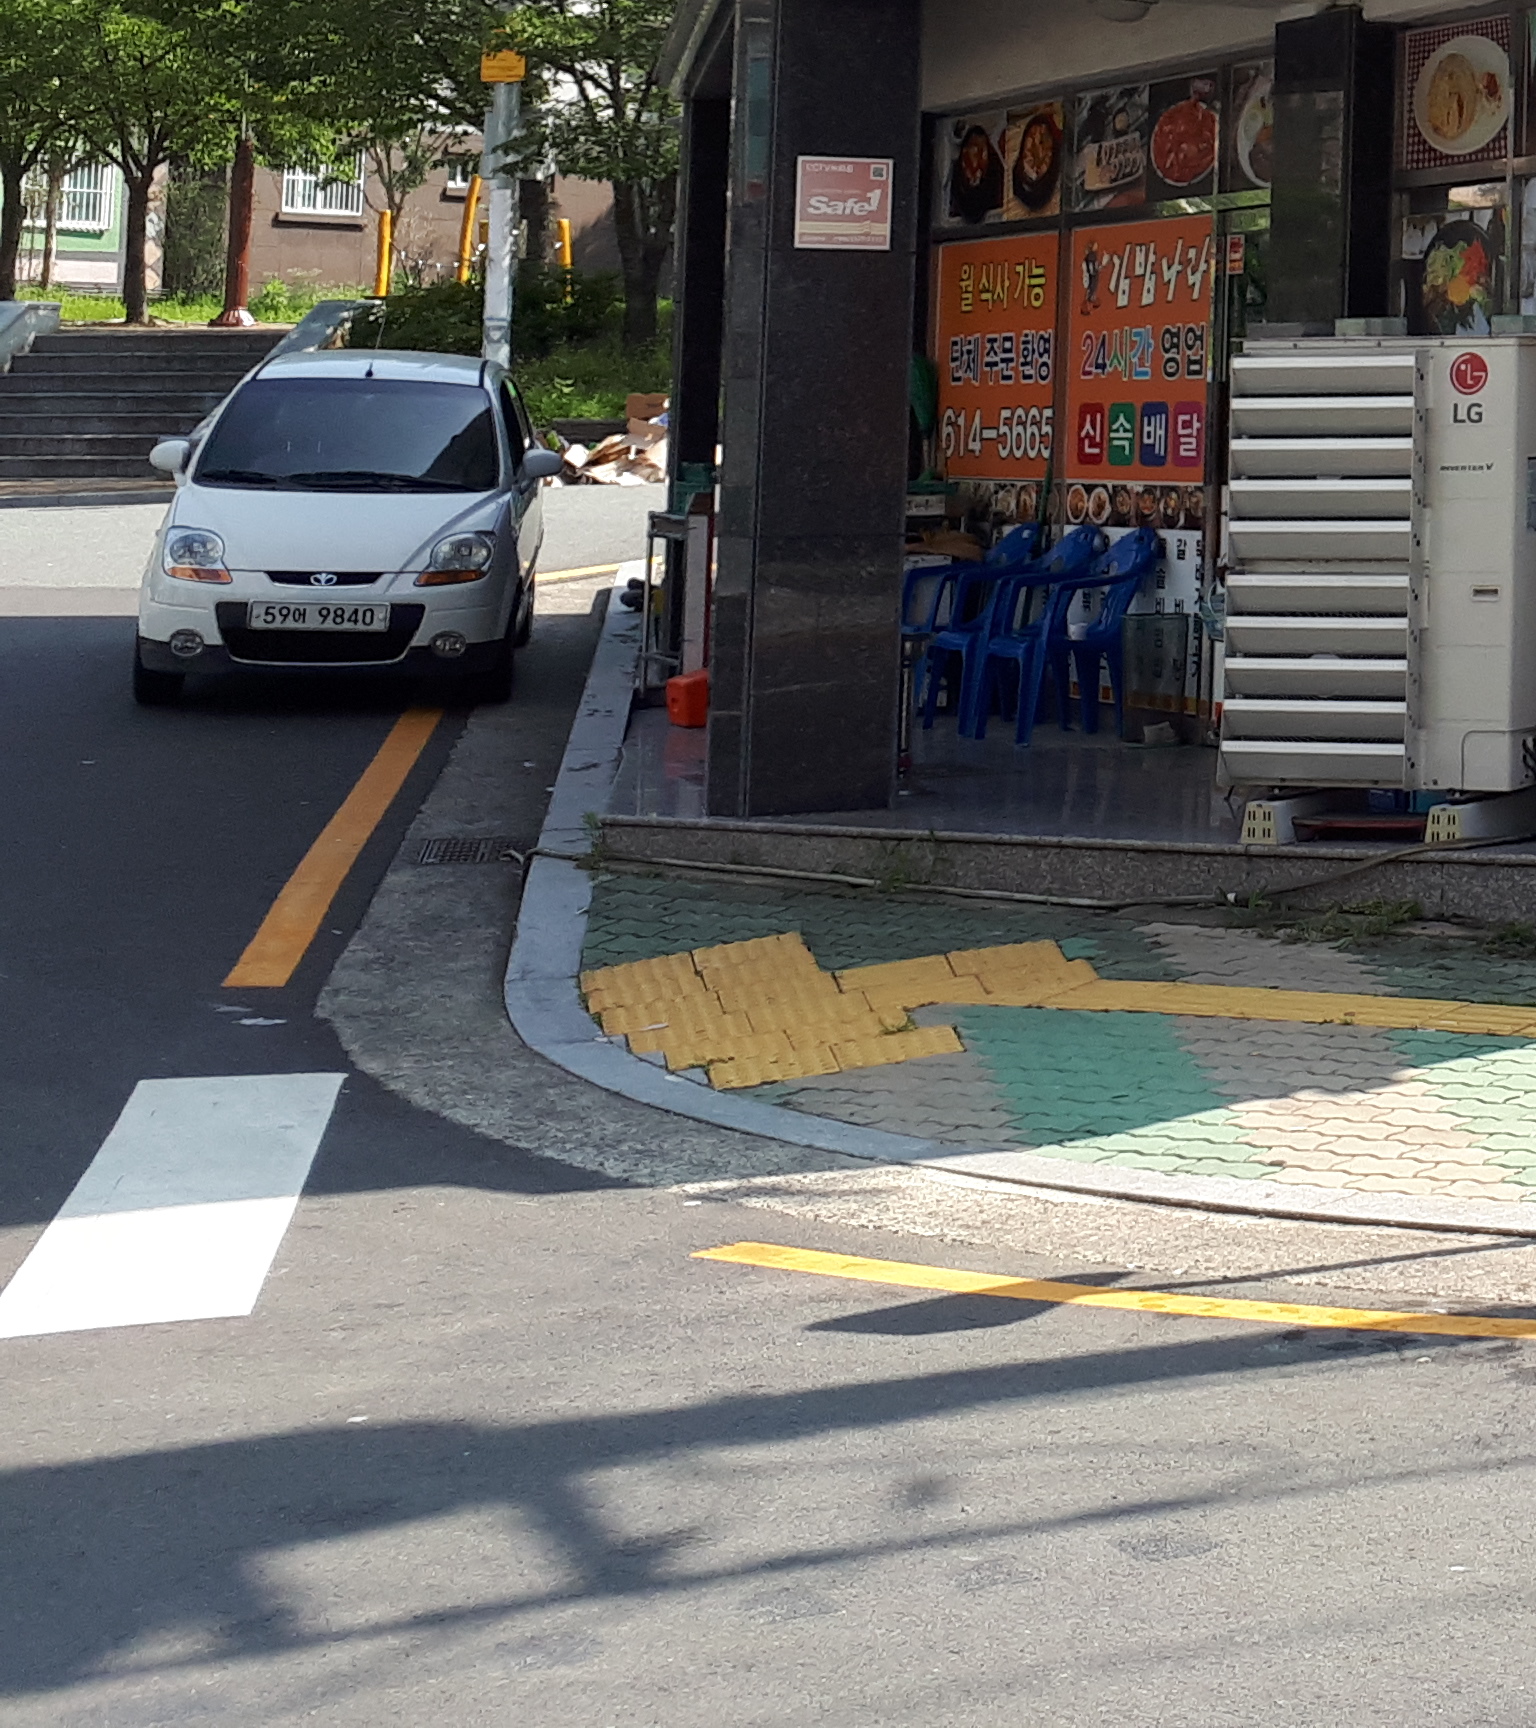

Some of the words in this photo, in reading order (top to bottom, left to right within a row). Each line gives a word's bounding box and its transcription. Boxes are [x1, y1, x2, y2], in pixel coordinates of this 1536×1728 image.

[959, 263, 975, 314] 월
[979, 261, 1010, 312] 식사
[1014, 257, 1047, 309] 가능
[949, 332, 982, 386] 단체
[984, 331, 1017, 386] 주문
[1018, 328, 1054, 386] 환영
[1080, 324, 1154, 382] 24시간
[1160, 321, 1208, 381] 영업
[942, 405, 1055, 460] 614-5665
[1080, 412, 1202, 458] 신속배달
[1452, 402, 1484, 424] LG
[262, 605, 307, 626] 59어
[317, 606, 375, 626] 9840
